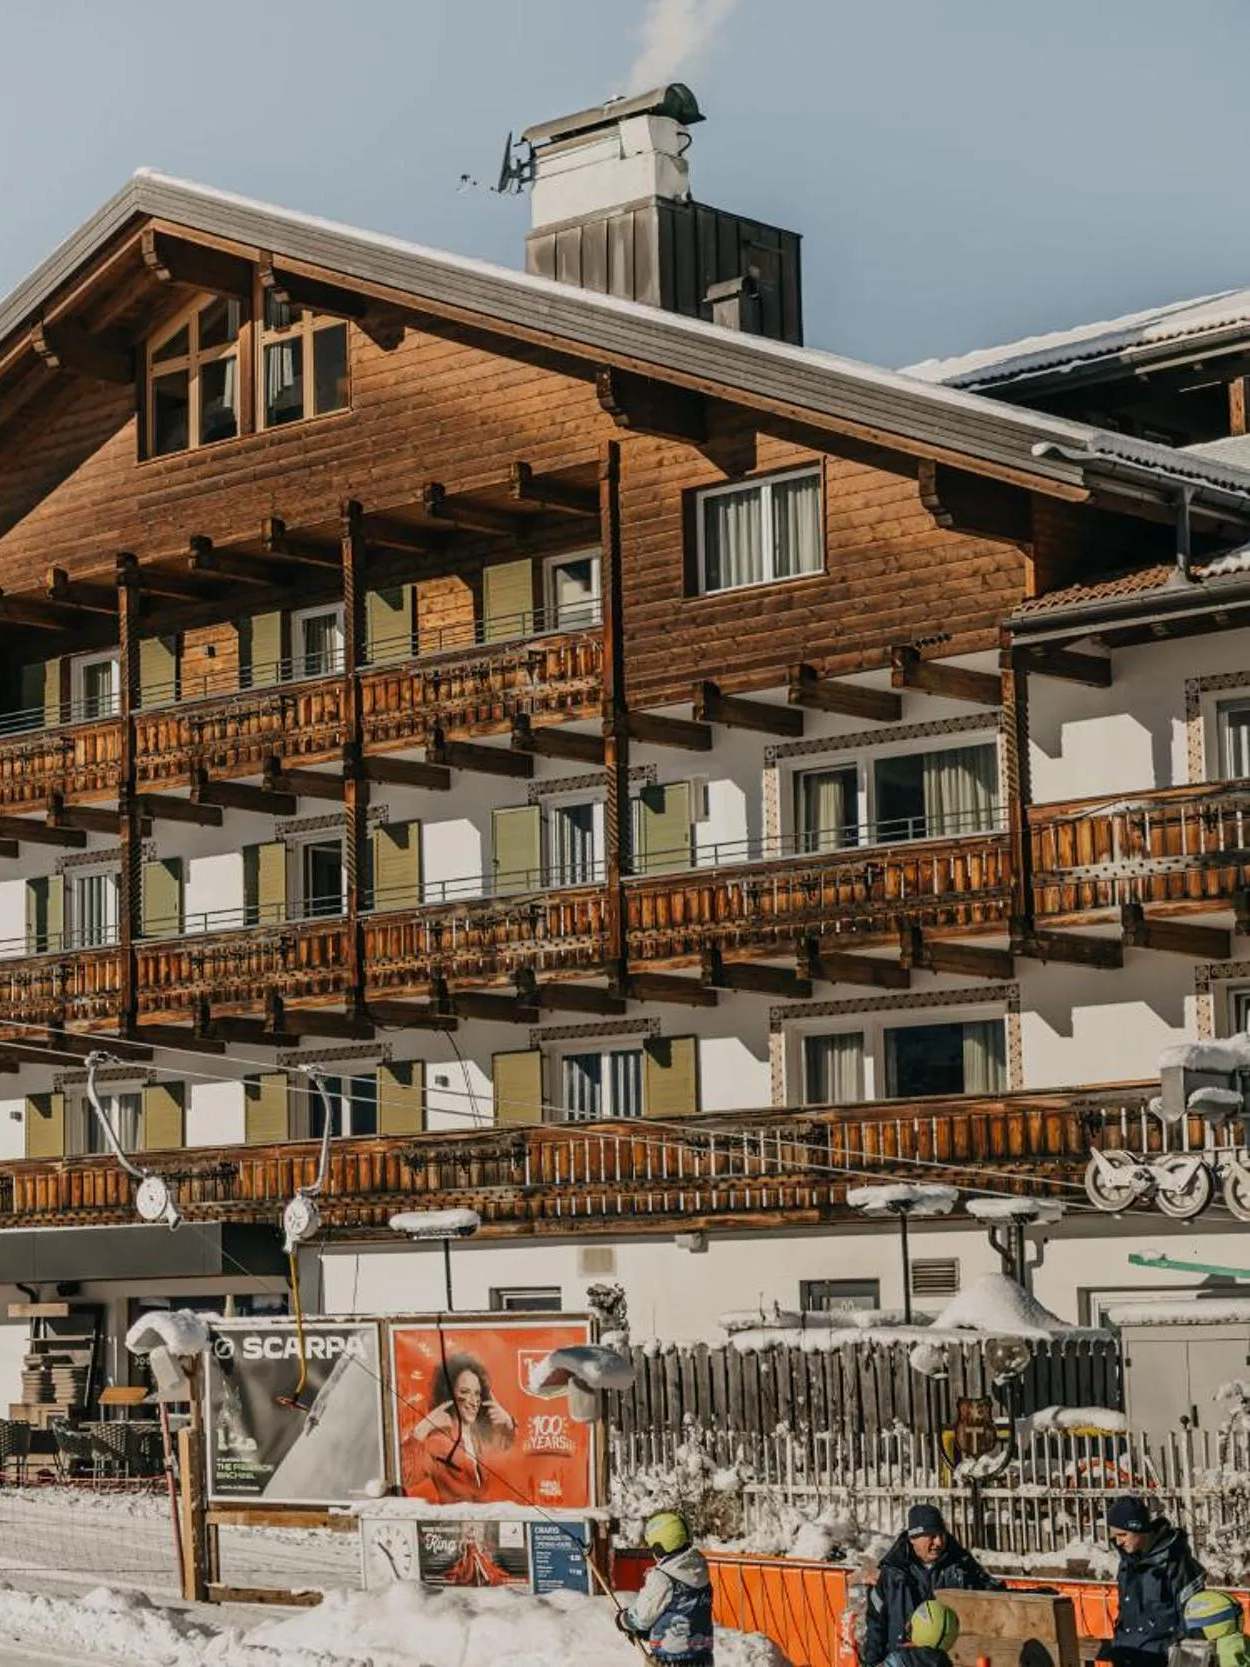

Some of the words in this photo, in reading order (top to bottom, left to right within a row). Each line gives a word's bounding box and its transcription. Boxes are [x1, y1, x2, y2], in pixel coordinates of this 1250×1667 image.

[242, 1336, 368, 1360] SCARPA
[533, 1414, 563, 1437] 100
[530, 1435, 567, 1450] YEARS
